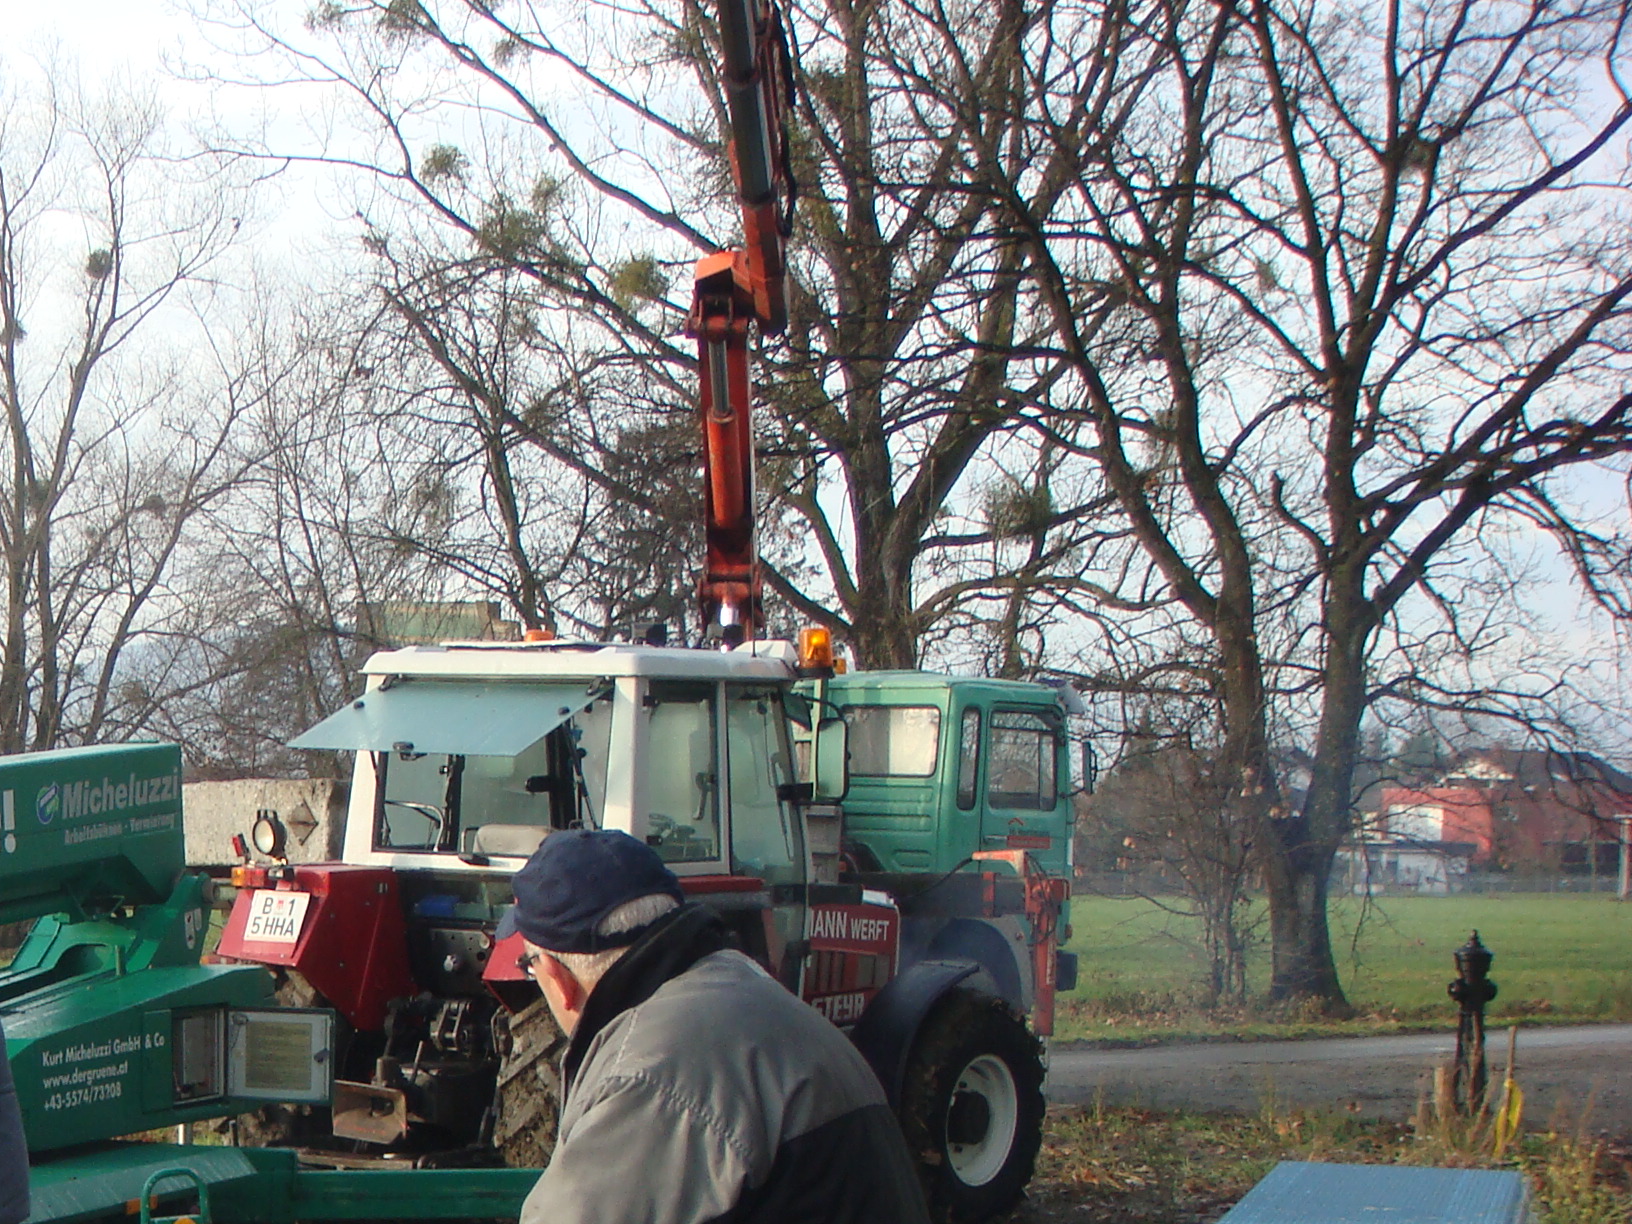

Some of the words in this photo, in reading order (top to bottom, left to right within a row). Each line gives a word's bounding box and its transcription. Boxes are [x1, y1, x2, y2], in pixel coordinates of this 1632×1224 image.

[61, 767, 179, 820] Micheluzzi
[262, 897, 273, 915] B
[263, 917, 294, 936] HHA
[810, 910, 848, 939] ANN
[850, 918, 889, 941] WERFT
[42, 1050, 63, 1067] Kurt
[65, 1041, 112, 1063] Micheluzzi
[113, 1035, 141, 1055] GmbH
[153, 1032, 165, 1048] Co
[42, 1060, 128, 1089] www.dergruene.at
